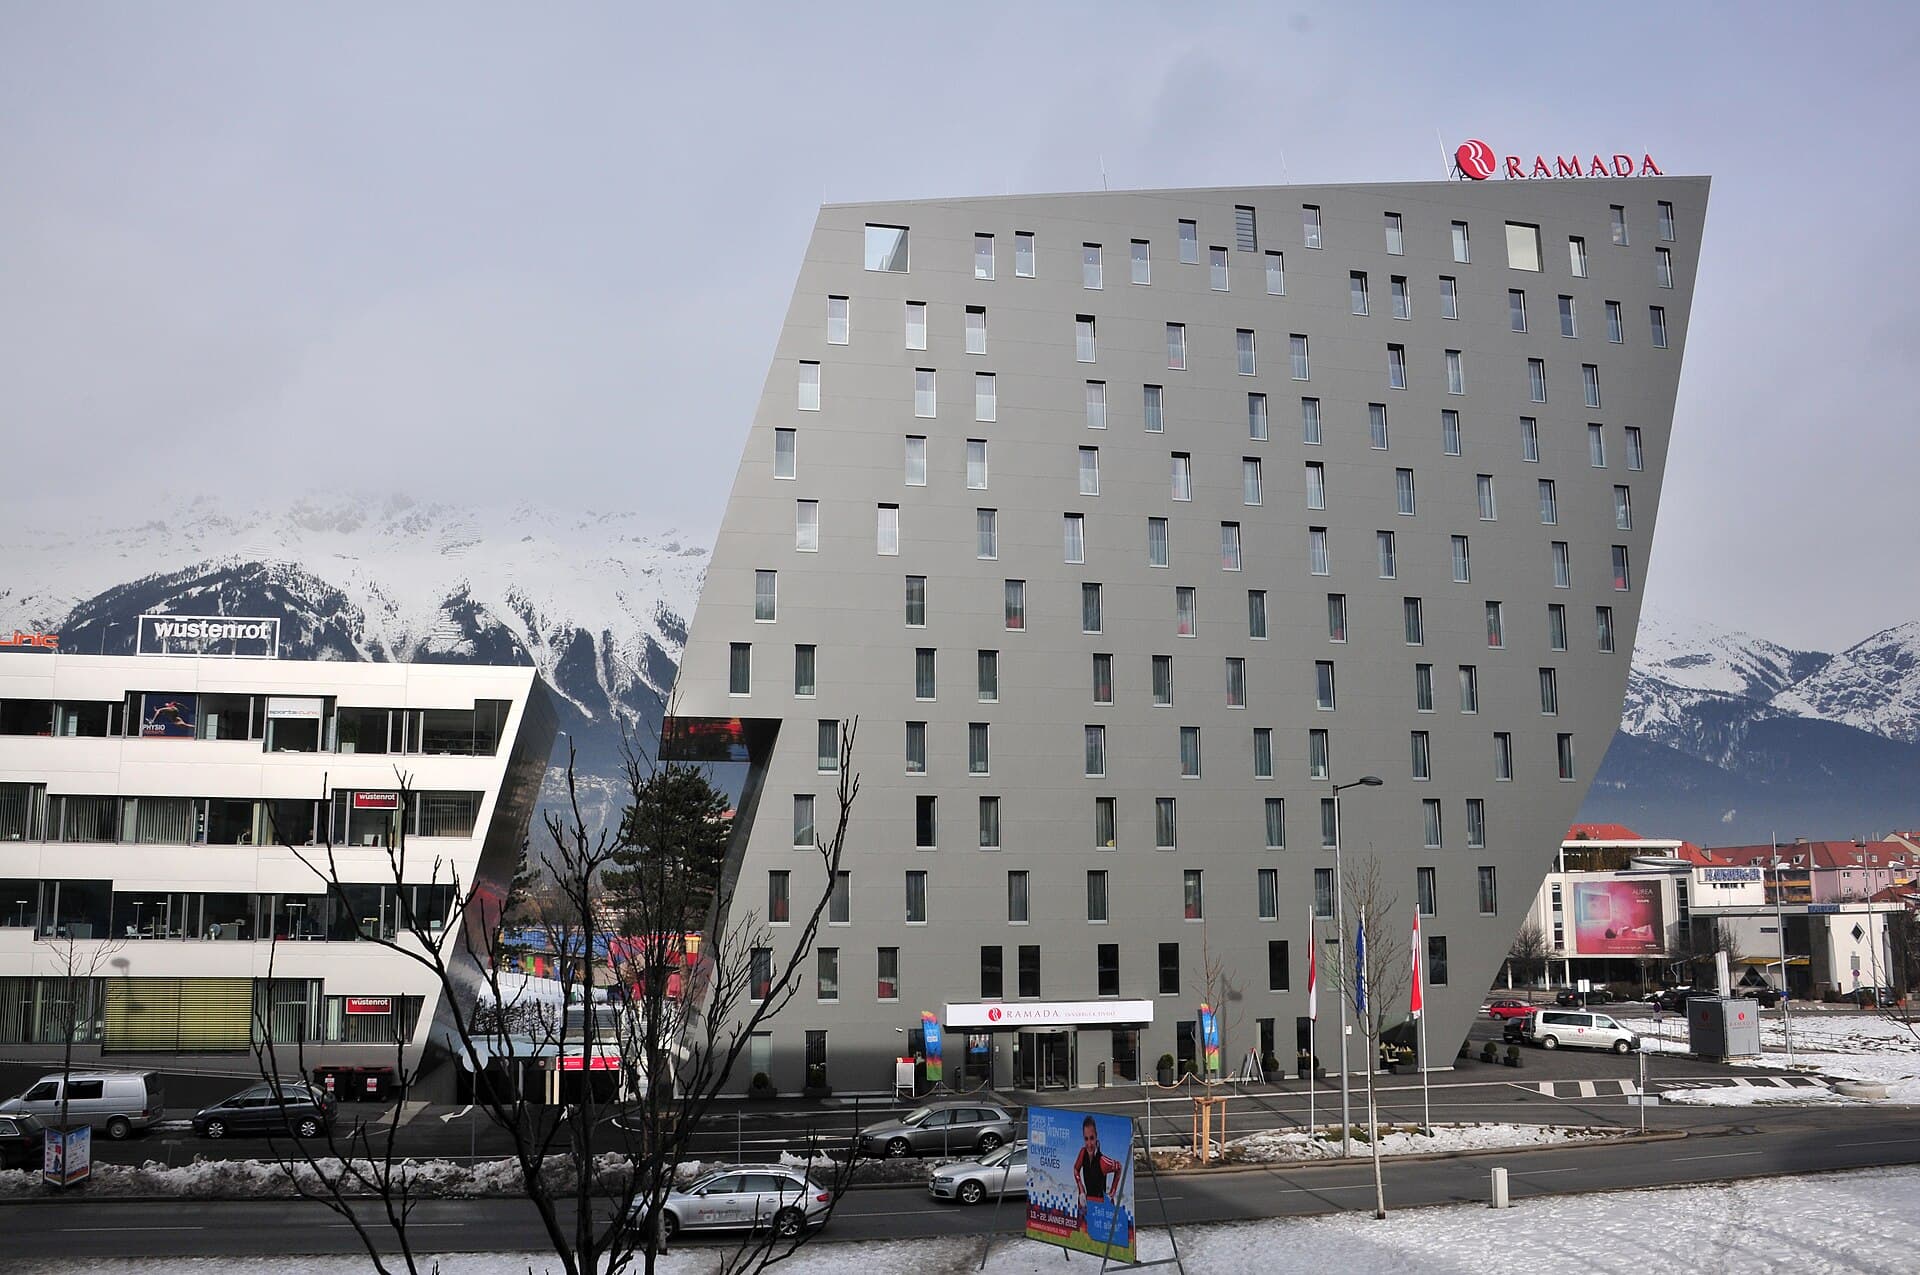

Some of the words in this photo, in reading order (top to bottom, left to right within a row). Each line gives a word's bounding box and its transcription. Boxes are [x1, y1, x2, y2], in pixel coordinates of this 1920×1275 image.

[1505, 153, 1664, 178] RAMADA
[1006, 1009, 1059, 1018] RAMADA
[1047, 1126, 1071, 1137] WINTER
[1031, 1144, 1057, 1158] OLYMPIC
[1040, 1157, 1060, 1169] GAMES
